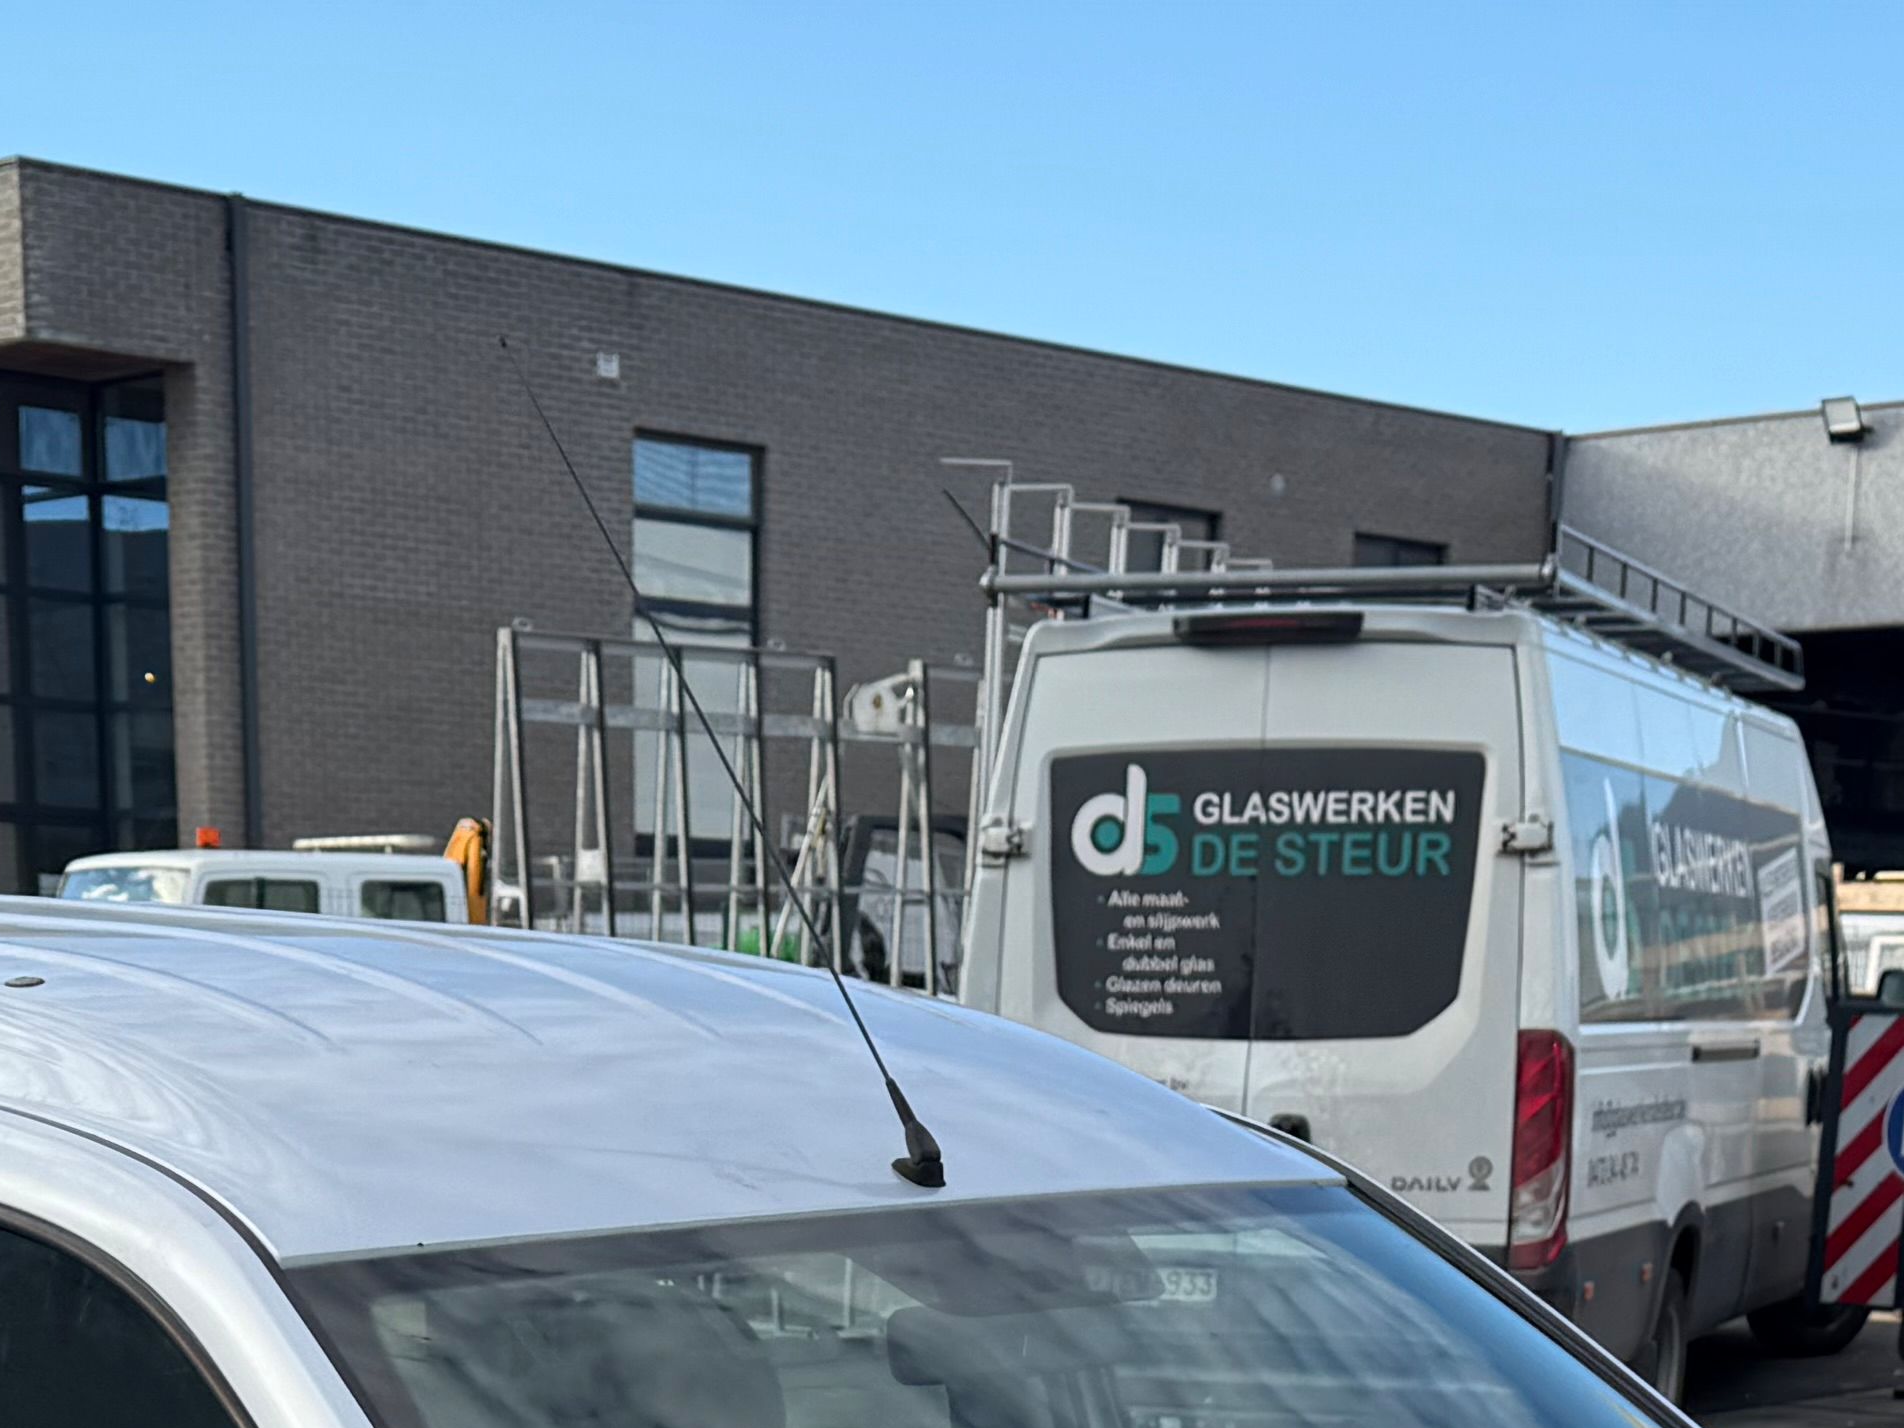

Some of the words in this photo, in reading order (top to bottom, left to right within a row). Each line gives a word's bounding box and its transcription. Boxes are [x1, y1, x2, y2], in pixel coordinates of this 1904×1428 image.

[1194, 789, 1455, 826] GLASWERKEN
[1191, 832, 1259, 877] DE
[1273, 831, 1452, 878] STEUR
[1391, 1176, 1462, 1192] DAILY
